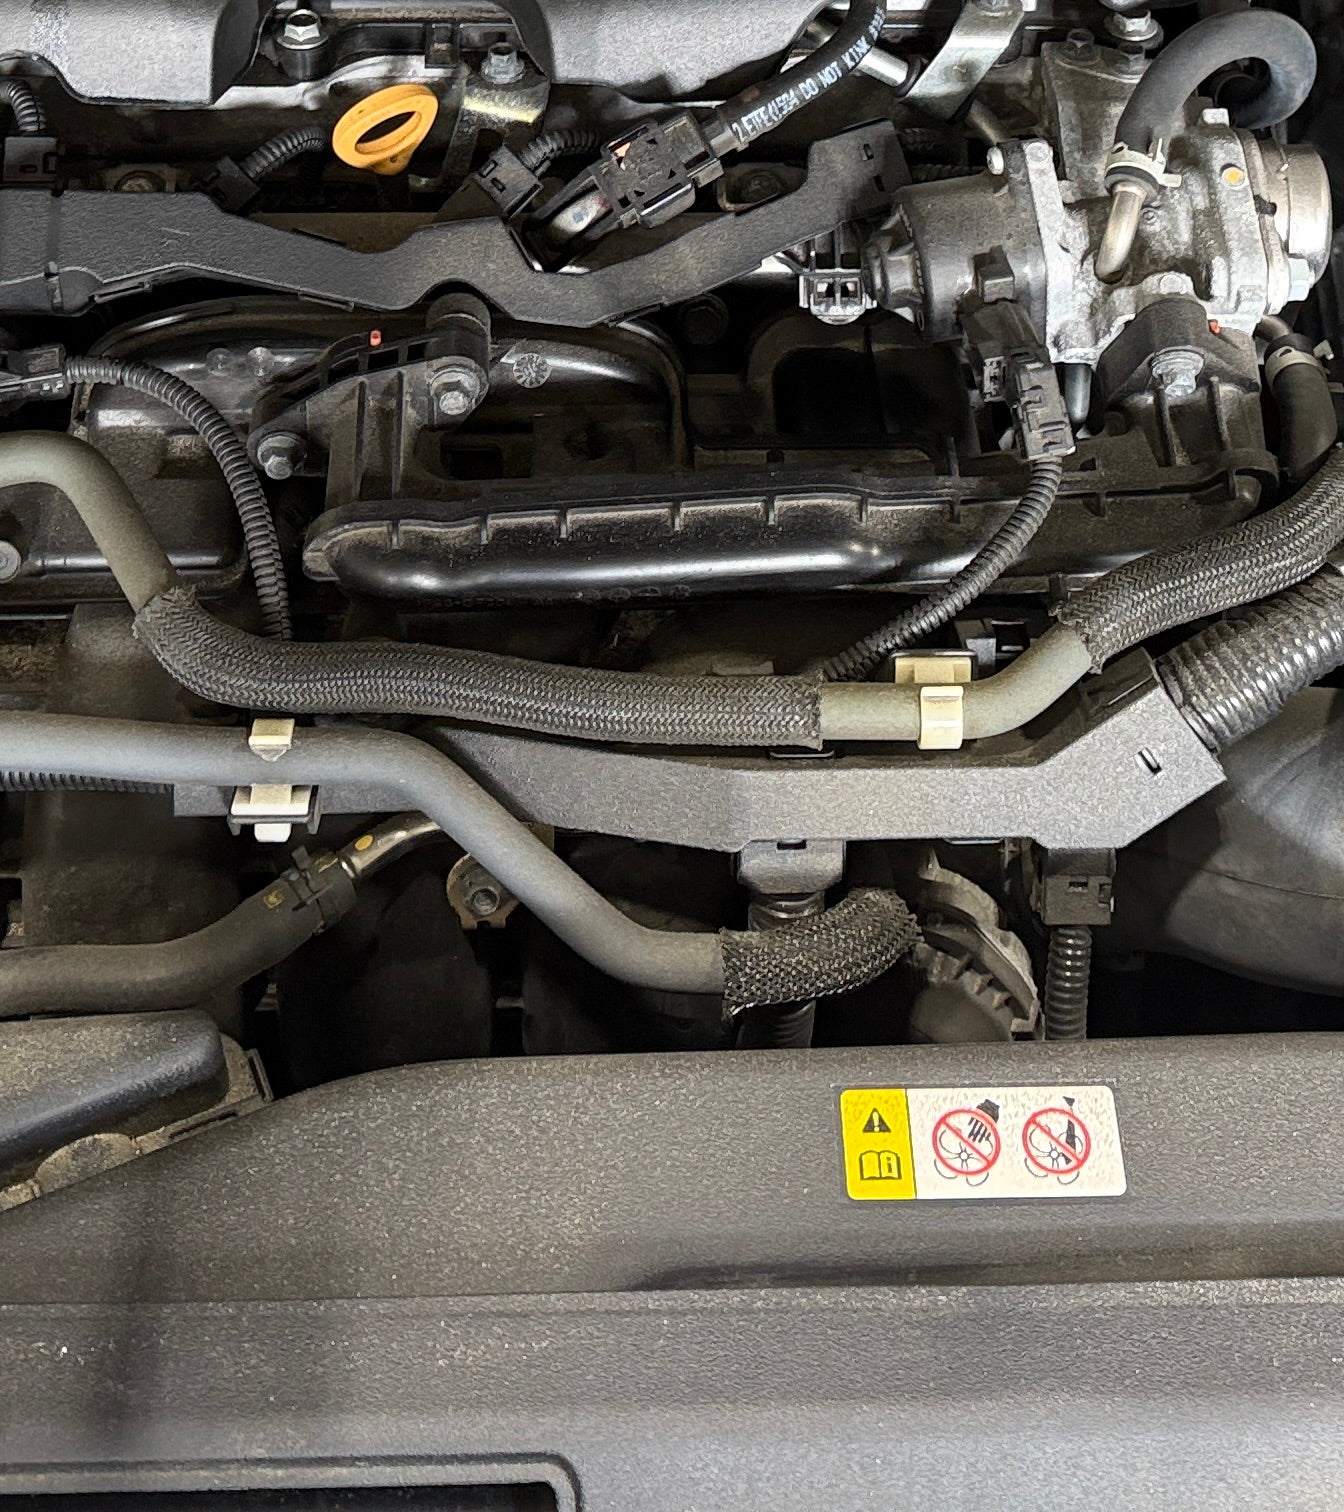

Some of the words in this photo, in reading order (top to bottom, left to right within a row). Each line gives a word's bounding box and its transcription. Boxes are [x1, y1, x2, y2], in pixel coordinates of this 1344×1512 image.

[798, 78, 820, 100] DO
[817, 61, 843, 88] NOT
[841, 36, 871, 70] KINK
